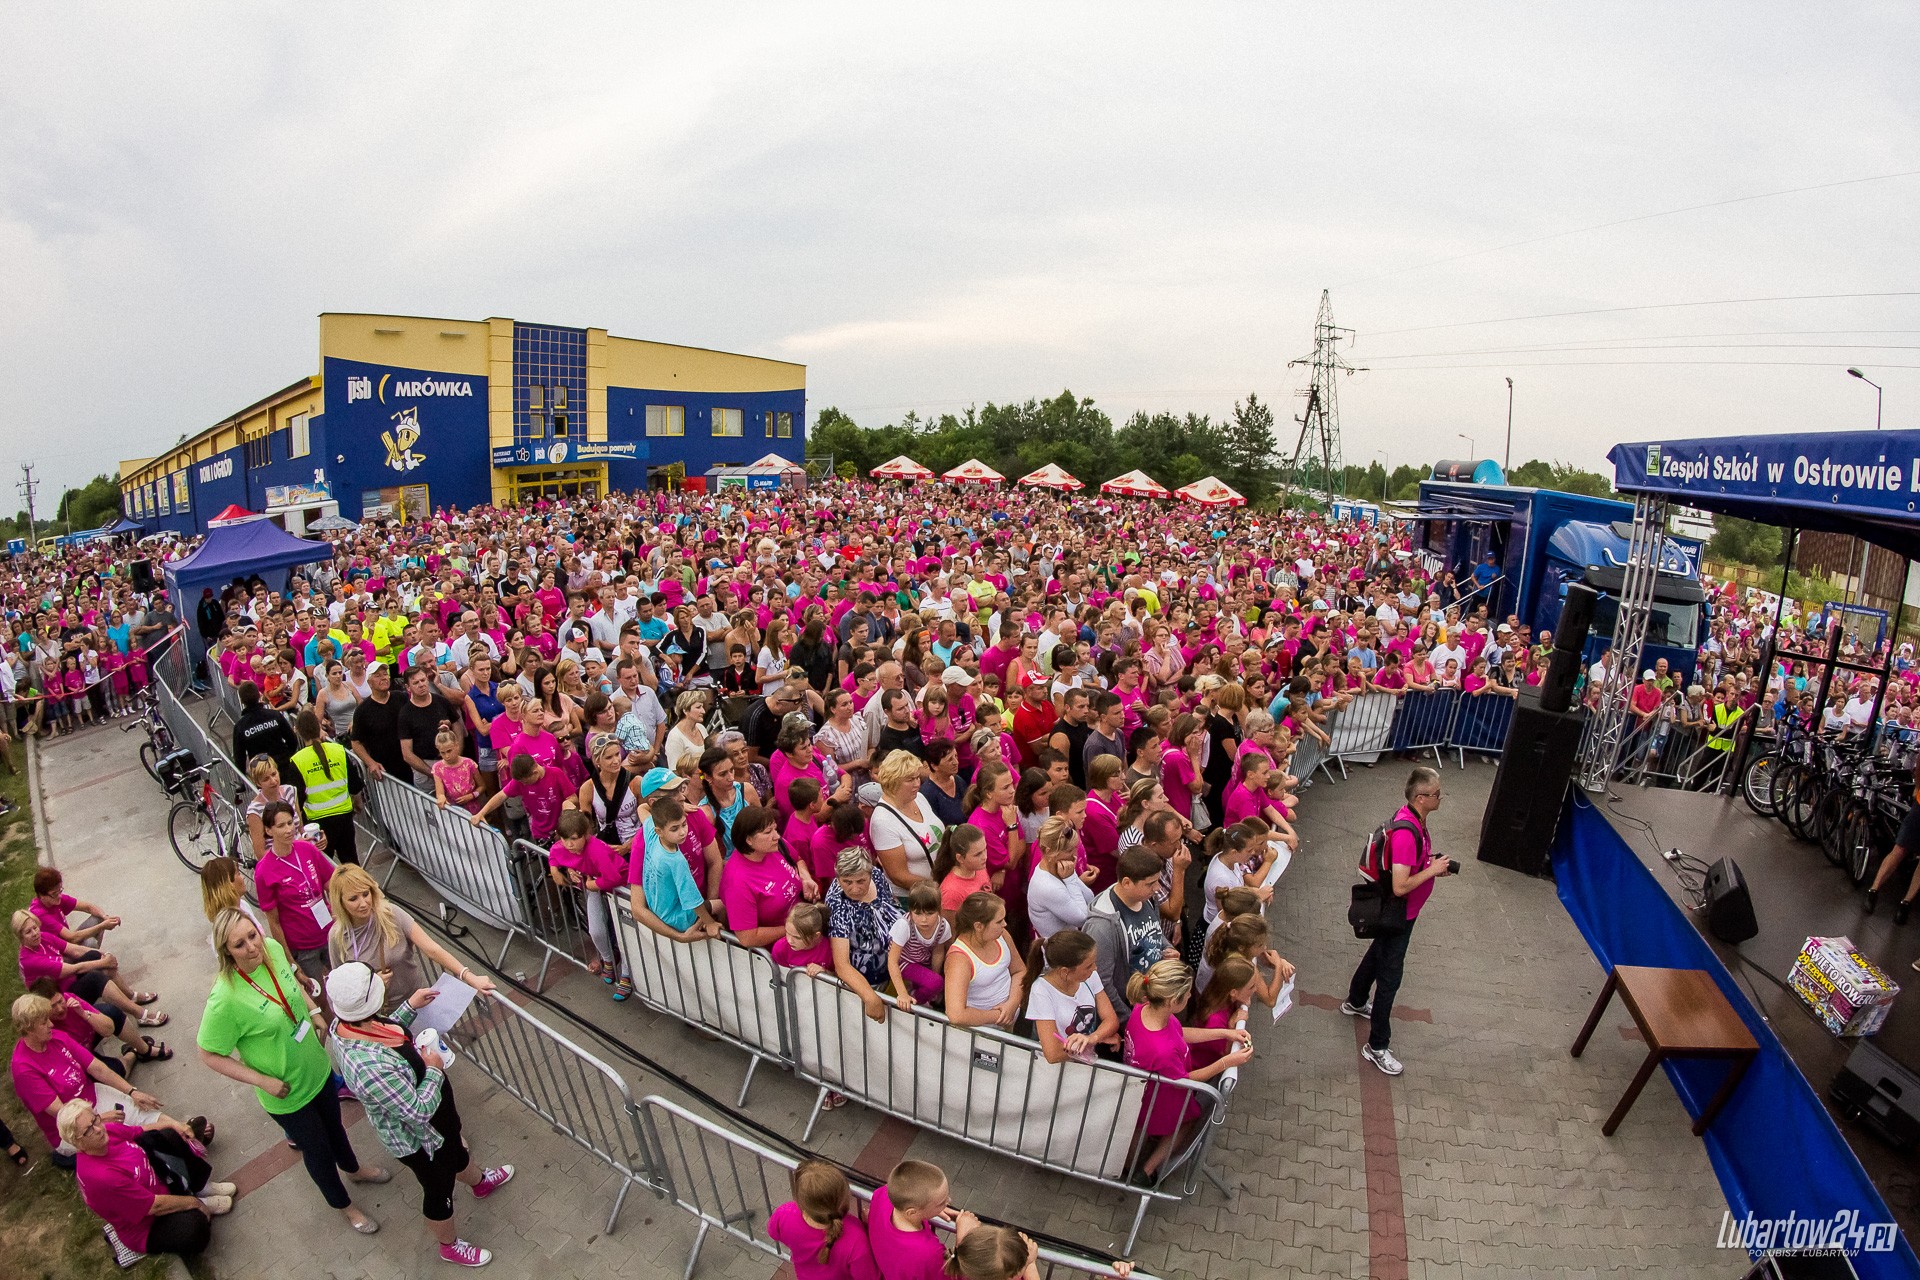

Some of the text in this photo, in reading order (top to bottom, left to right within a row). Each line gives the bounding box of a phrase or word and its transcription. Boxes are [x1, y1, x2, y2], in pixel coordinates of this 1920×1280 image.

[348, 376, 371, 403] psb
[395, 377, 472, 397] MRÓWKA
[314, 468, 325, 484] 34
[1662, 454, 1709, 483] Zespół
[1713, 452, 1758, 482] Szkół
[1767, 463, 1785, 483] w
[1794, 455, 1902, 491] Ostrowie
[244, 719, 279, 737] OCHRONA
[1798, 951, 1811, 966] 29
[1807, 962, 1836, 994] czerwca
